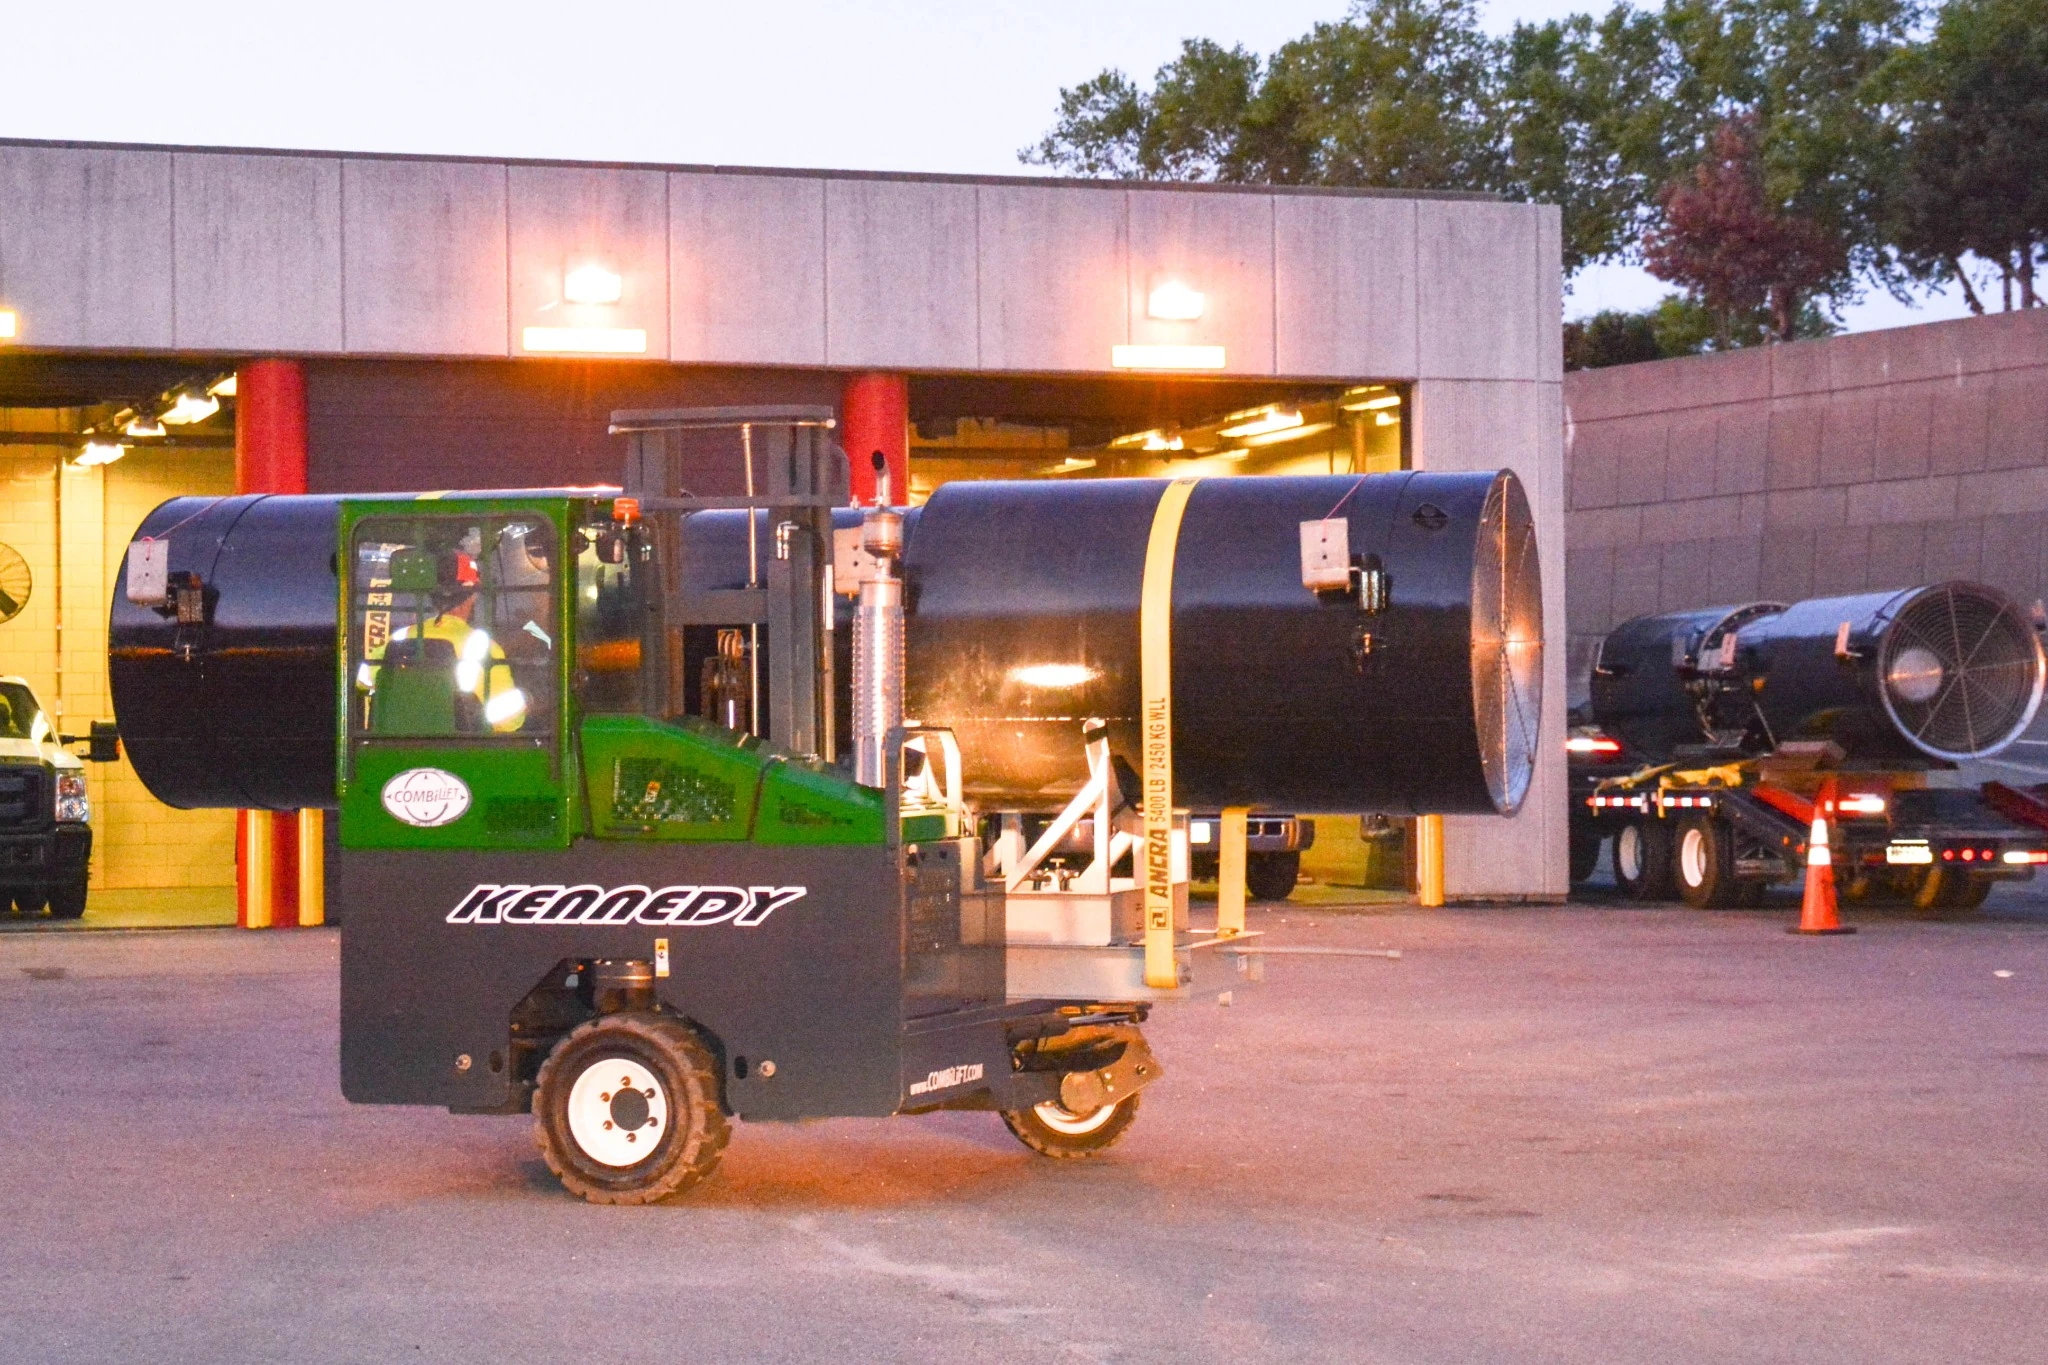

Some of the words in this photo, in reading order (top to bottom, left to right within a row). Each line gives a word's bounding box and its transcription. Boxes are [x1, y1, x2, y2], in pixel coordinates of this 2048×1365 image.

[1149, 698, 1166, 720] WLL
[1149, 724, 1166, 740] KG
[1149, 743, 1166, 770] 2450
[1149, 779, 1166, 793] LB
[1149, 796, 1166, 822] 5400
[1149, 829, 1169, 899] ANCRA
